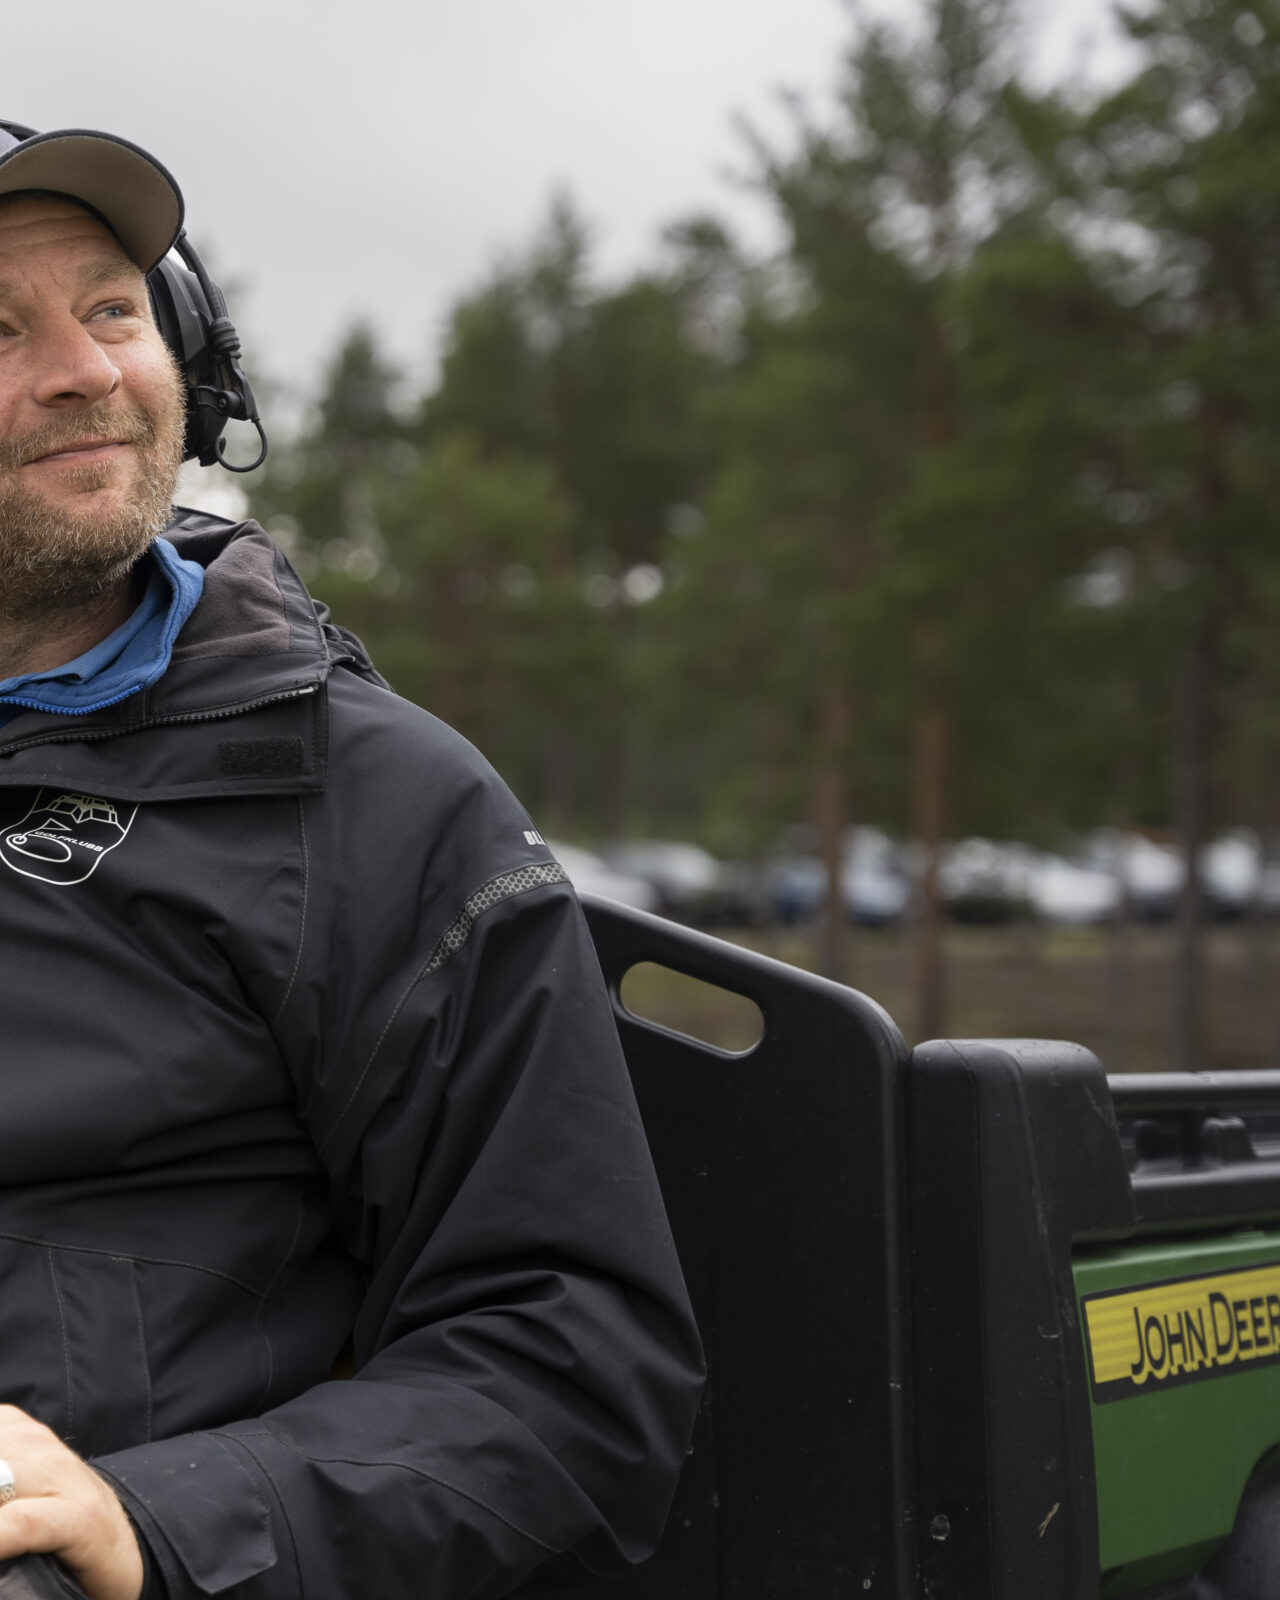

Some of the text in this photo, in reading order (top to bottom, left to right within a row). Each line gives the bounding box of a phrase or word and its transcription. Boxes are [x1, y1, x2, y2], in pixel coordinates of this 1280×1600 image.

[34, 831, 105, 852] GOLFKLUBB
[1130, 1292, 1280, 1378] JOHN DEER
